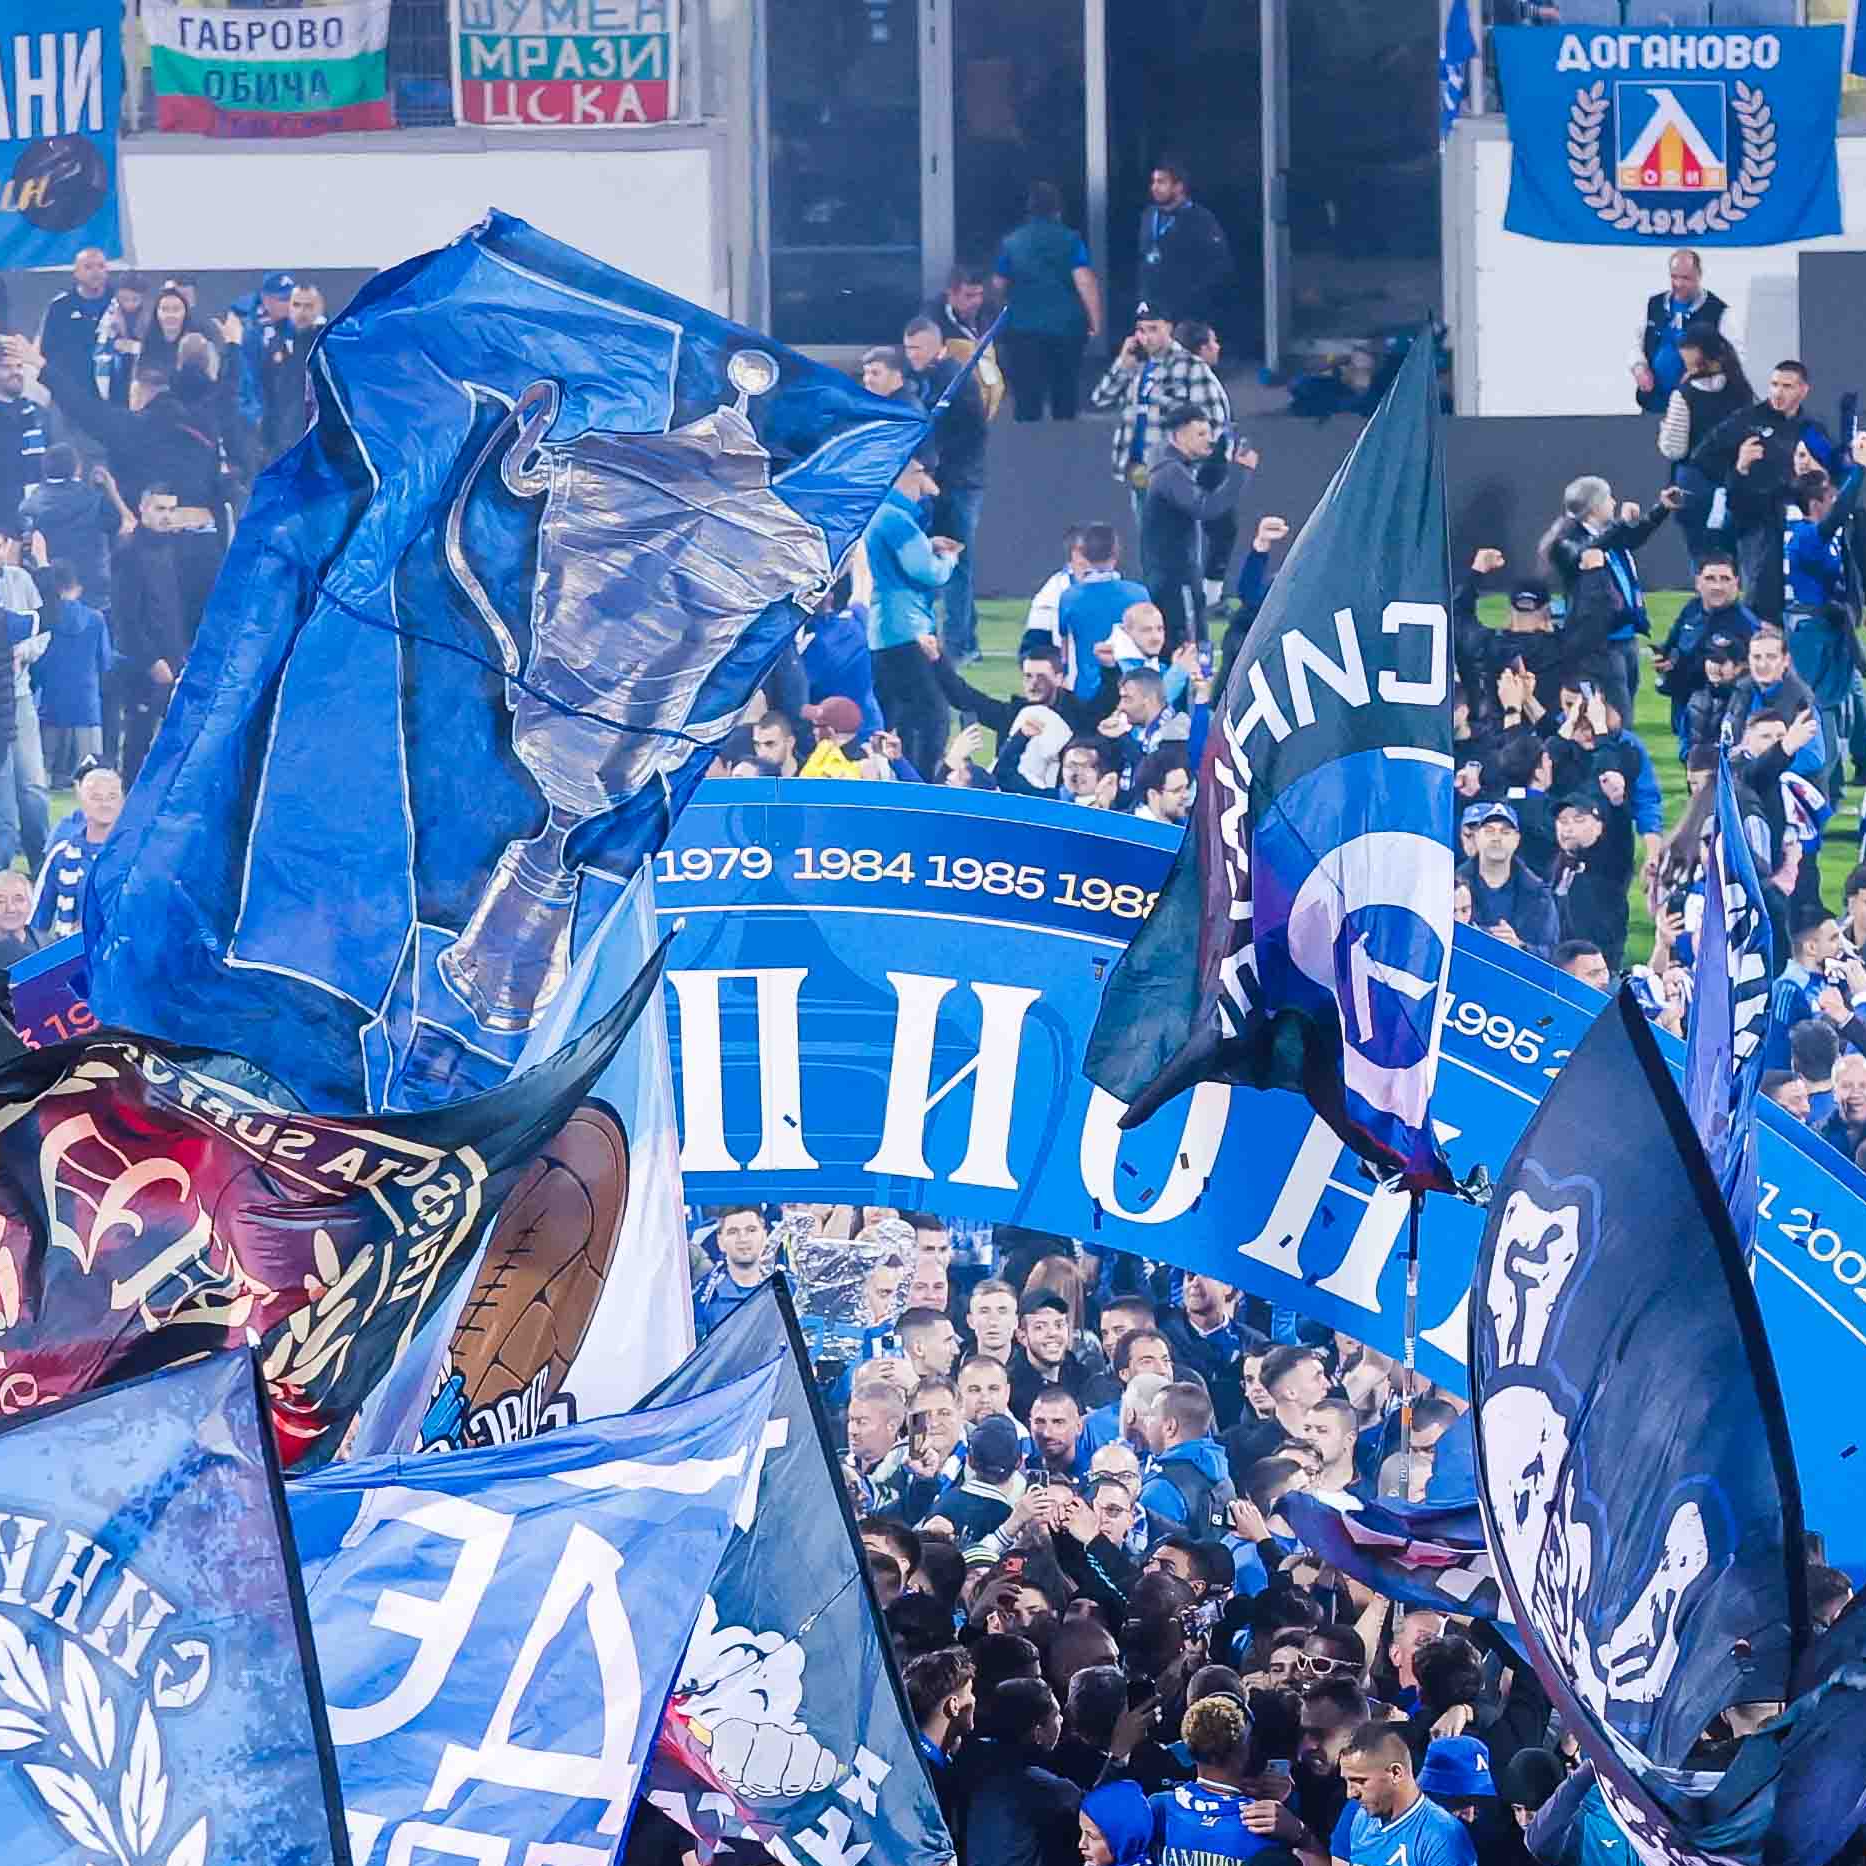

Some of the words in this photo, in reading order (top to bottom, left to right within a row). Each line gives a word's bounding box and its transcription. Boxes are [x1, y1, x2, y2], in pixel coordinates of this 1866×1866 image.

[177, 16, 344, 52] ГАБРОВО
[1555, 34, 1781, 71] ДОГАНОВО
[471, 35, 664, 81] МРАЗИ
[202, 70, 330, 103] ОБИЧА
[483, 82, 650, 124] ЦСКА
[1636, 208, 1708, 236] 1914
[655, 846, 773, 884] 1979
[792, 847, 916, 885] 1984
[924, 855, 1045, 901] 1985
[1441, 988, 1545, 1067] 1995
